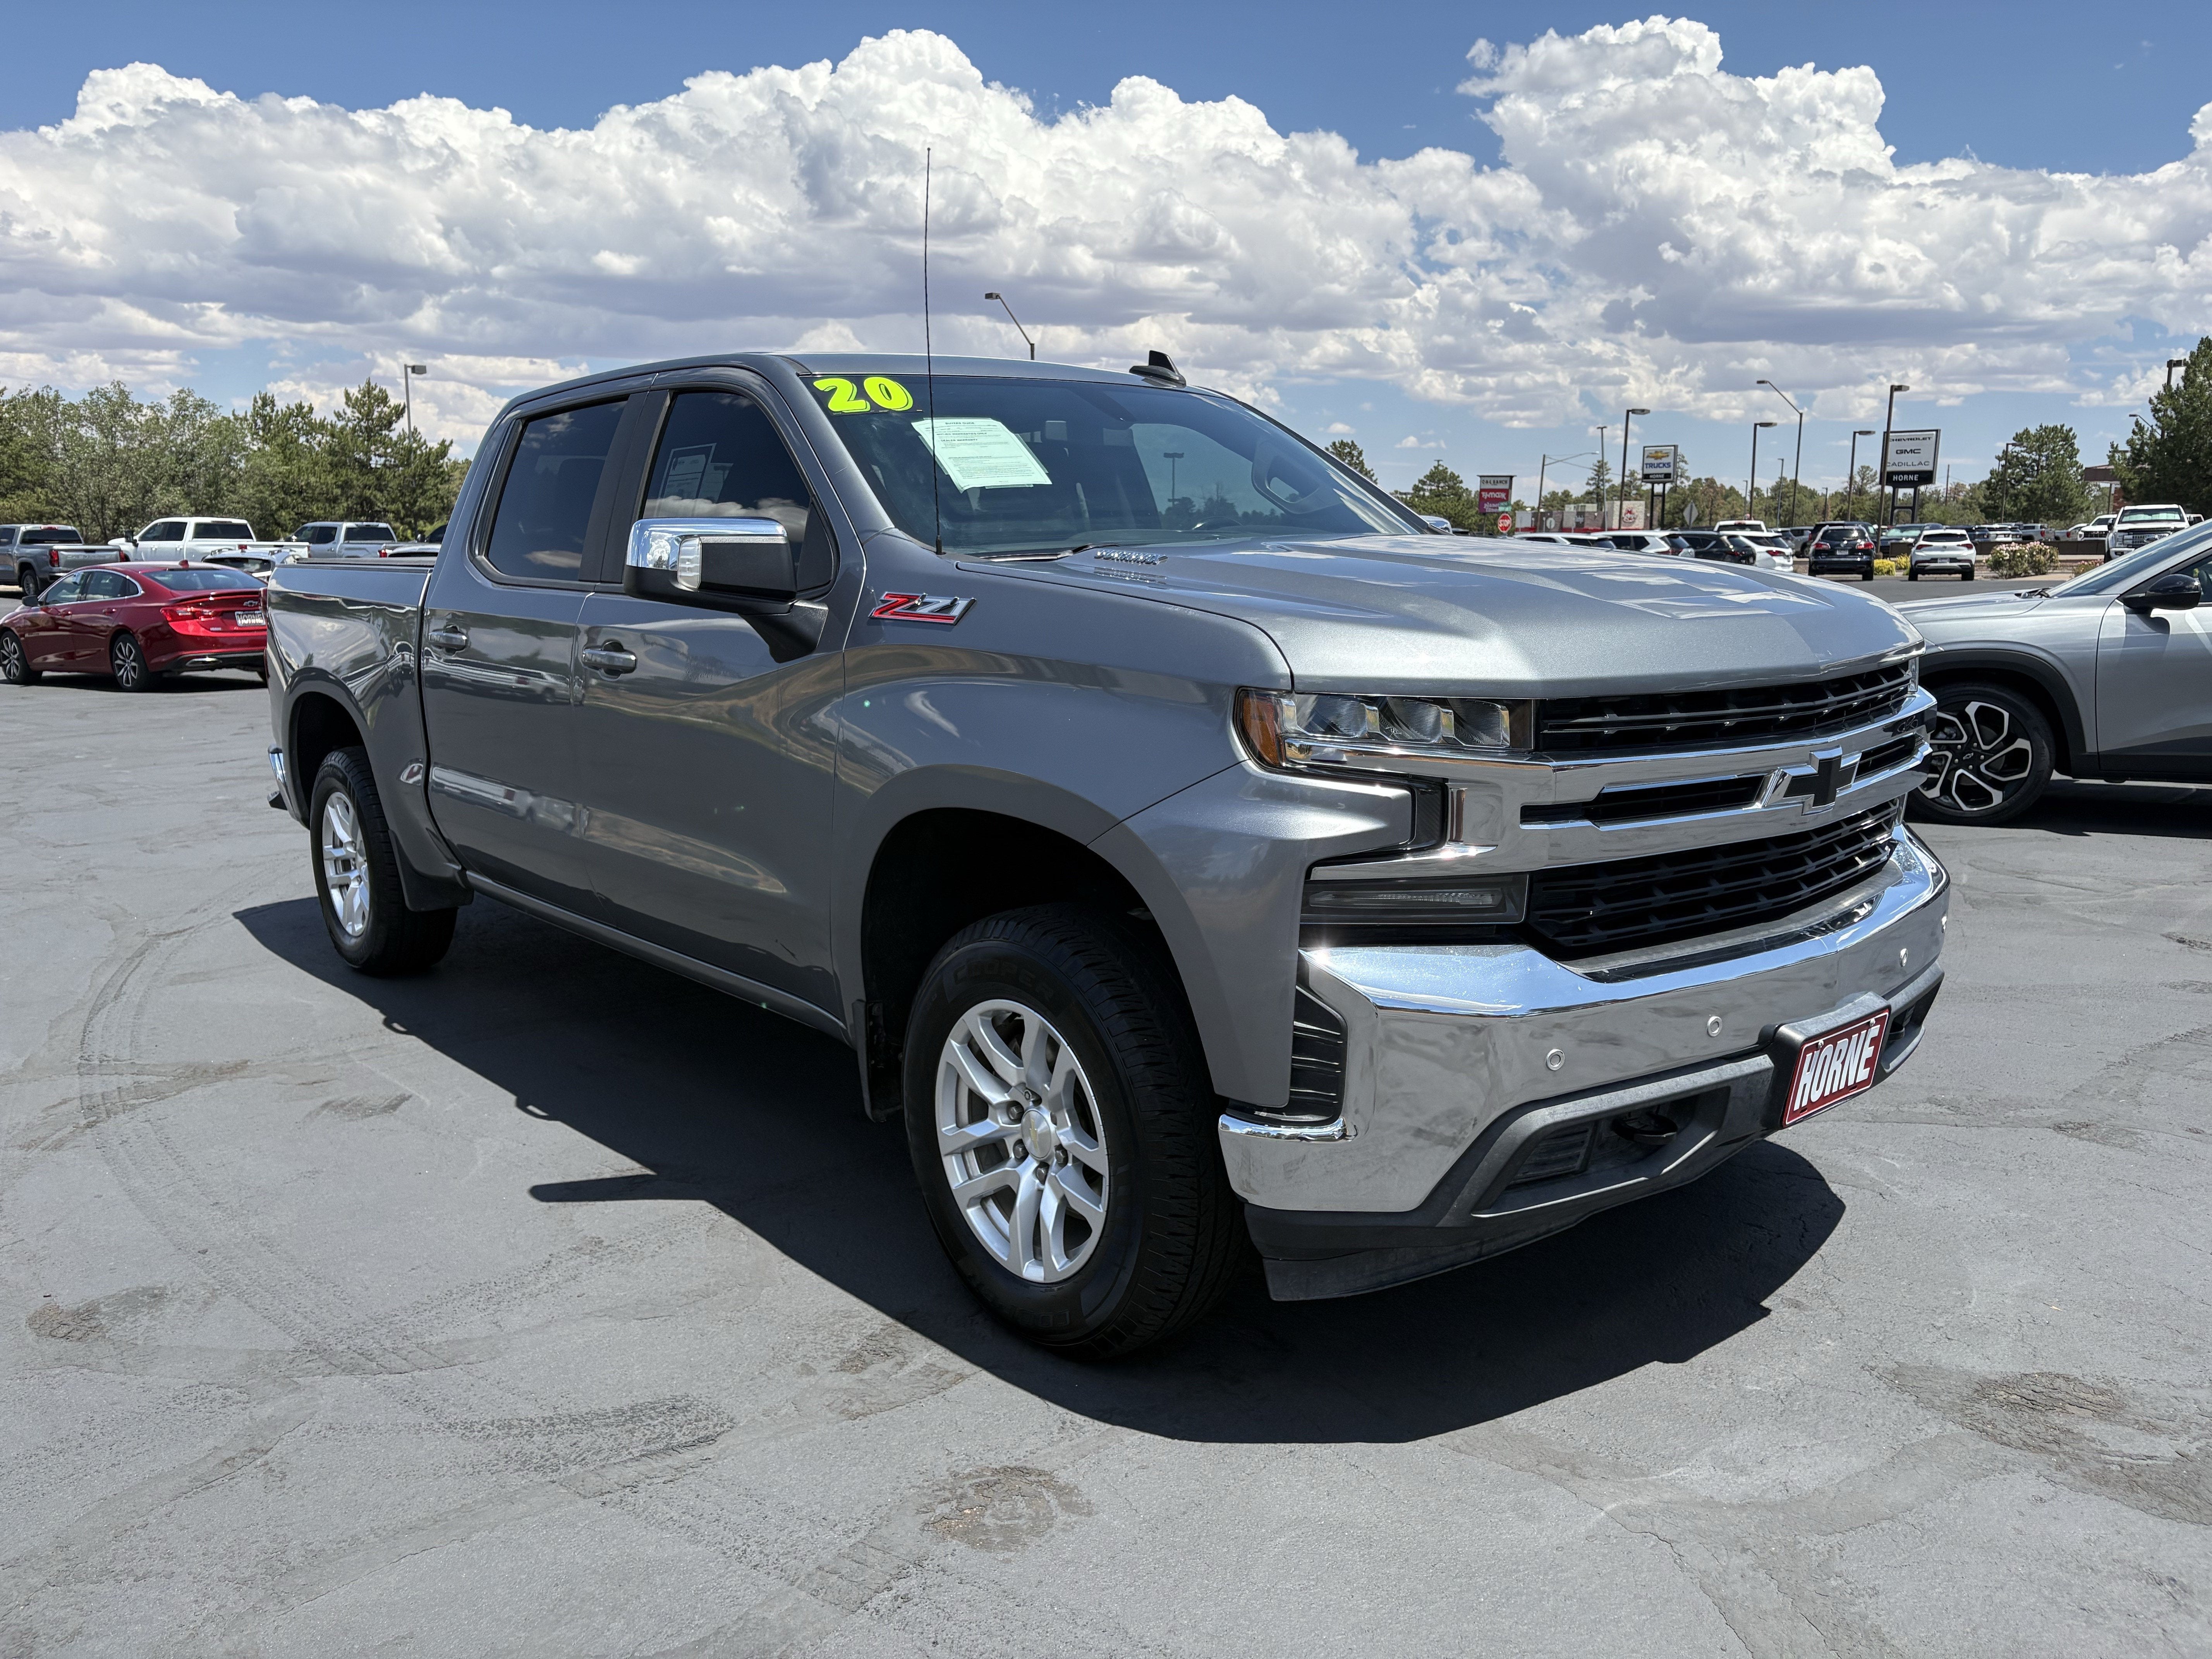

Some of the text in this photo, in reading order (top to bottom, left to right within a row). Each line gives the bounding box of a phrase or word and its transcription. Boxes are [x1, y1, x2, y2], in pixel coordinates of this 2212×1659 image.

[813, 377, 913, 413] 20
[1499, 519, 1510, 527] STOP
[237, 614, 263, 624] HORNE
[868, 591, 977, 625] Z71
[1793, 1025, 1881, 1111] HORNE
